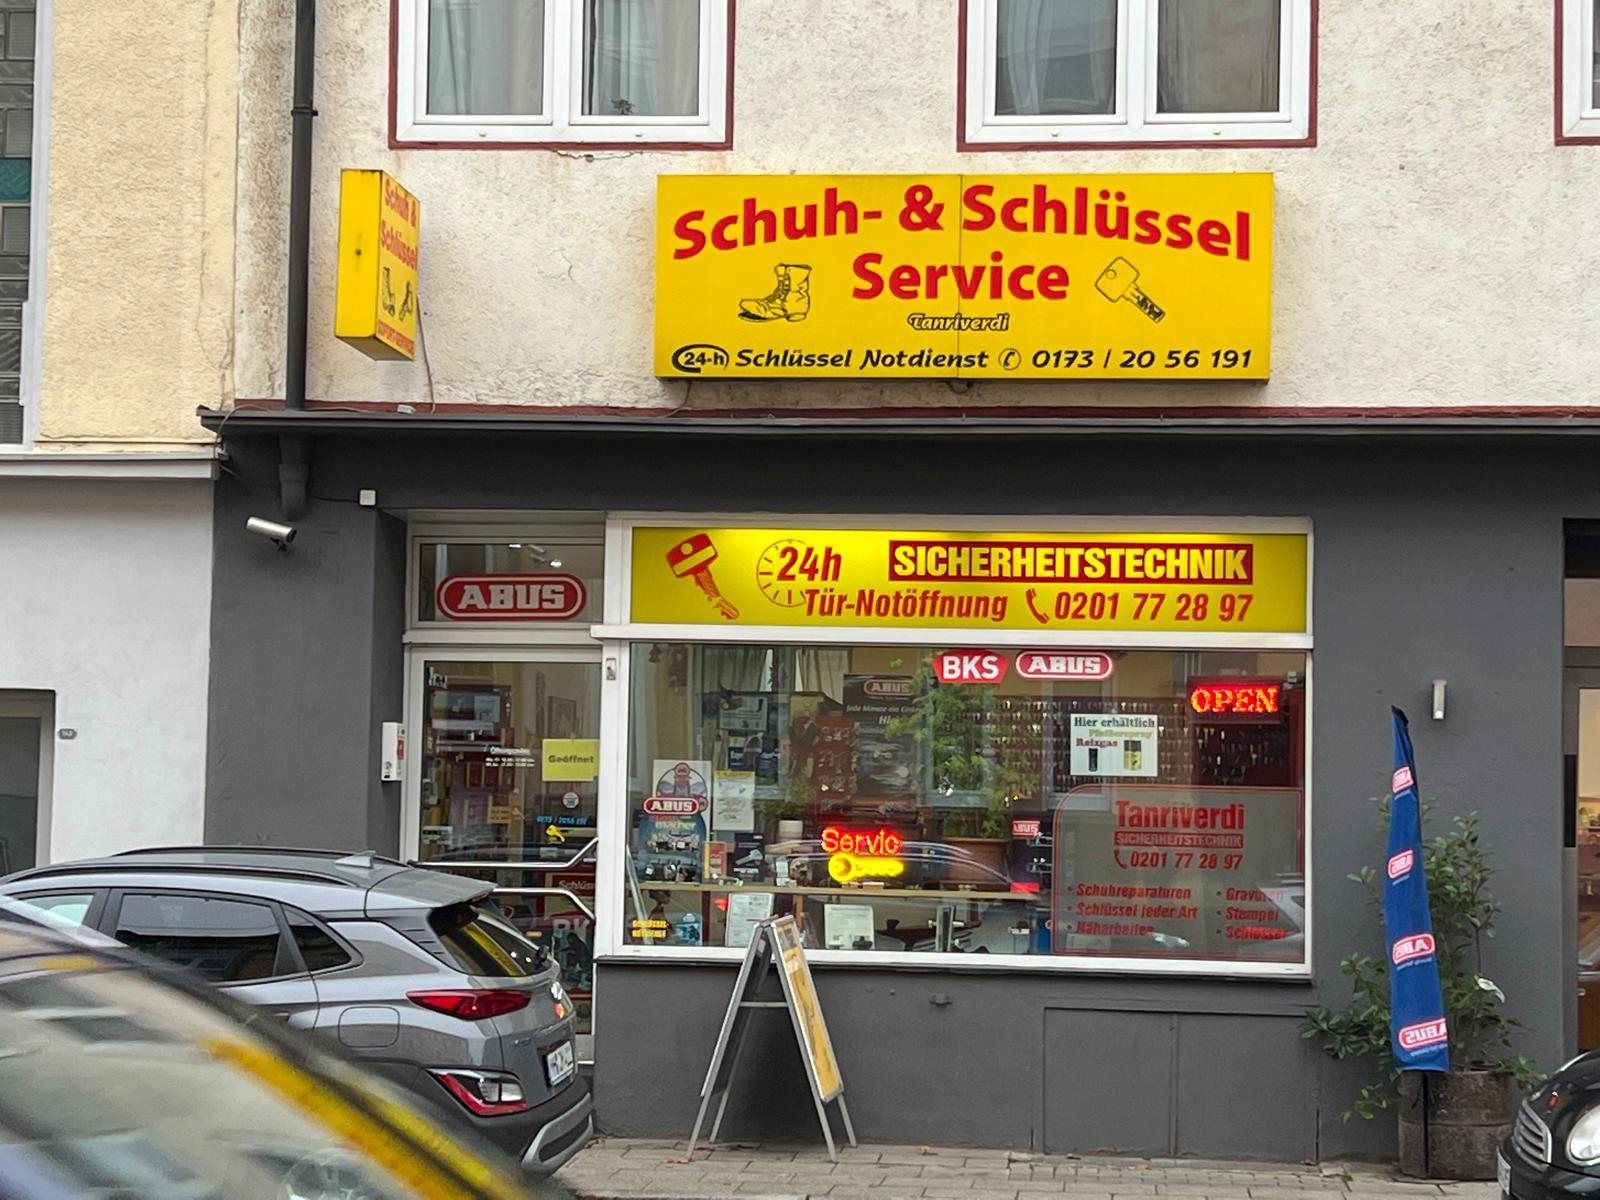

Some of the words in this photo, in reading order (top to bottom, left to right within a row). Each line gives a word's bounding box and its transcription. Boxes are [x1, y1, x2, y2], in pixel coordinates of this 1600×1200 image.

[673, 187, 882, 260] Schuh-
[899, 184, 944, 232] &
[962, 184, 1250, 261] Schlüssel
[852, 250, 1069, 300] Service
[907, 312, 1008, 331] Tanriverdi
[684, 351, 724, 366] 24-h
[735, 348, 851, 367] Schlüssel
[859, 349, 988, 370] Notdienst
[1032, 350, 1093, 368] 0173
[1120, 350, 1155, 368] 20
[1164, 350, 1200, 368] 56
[1211, 350, 1251, 368] 191
[777, 546, 842, 581] 24h
[894, 545, 1248, 580] SICHERHEITSTECHNIK
[458, 585, 564, 609] ABUS
[805, 588, 1008, 622] Tür-Notöffnung
[1055, 592, 1119, 620] 0201
[1133, 592, 1165, 621] 77
[1175, 593, 1209, 621] 28
[1219, 594, 1253, 622] 97
[943, 655, 999, 680] BKS
[1027, 656, 1100, 674] ABUS
[1191, 685, 1278, 713] OPEN
[1074, 717, 1097, 727] Hier
[1101, 716, 1154, 728] erhältlich
[548, 755, 594, 763] Geöffnet
[651, 800, 692, 811] ABUS
[1116, 800, 1245, 830] Tanriverdi
[1116, 832, 1242, 848] SICHERHEITSTECHNIK
[1131, 851, 1168, 868] 0201
[1175, 852, 1193, 869] 77
[1199, 852, 1217, 869] 28
[1224, 853, 1243, 870] 97
[1077, 883, 1191, 899] Schuhreparaturen
[1076, 902, 1137, 917] Schlüssel
[1141, 904, 1176, 919] jeder
[1178, 905, 1198, 918] Art
[1226, 906, 1279, 922] Stempel
[1076, 921, 1154, 935] Näharbeiten
